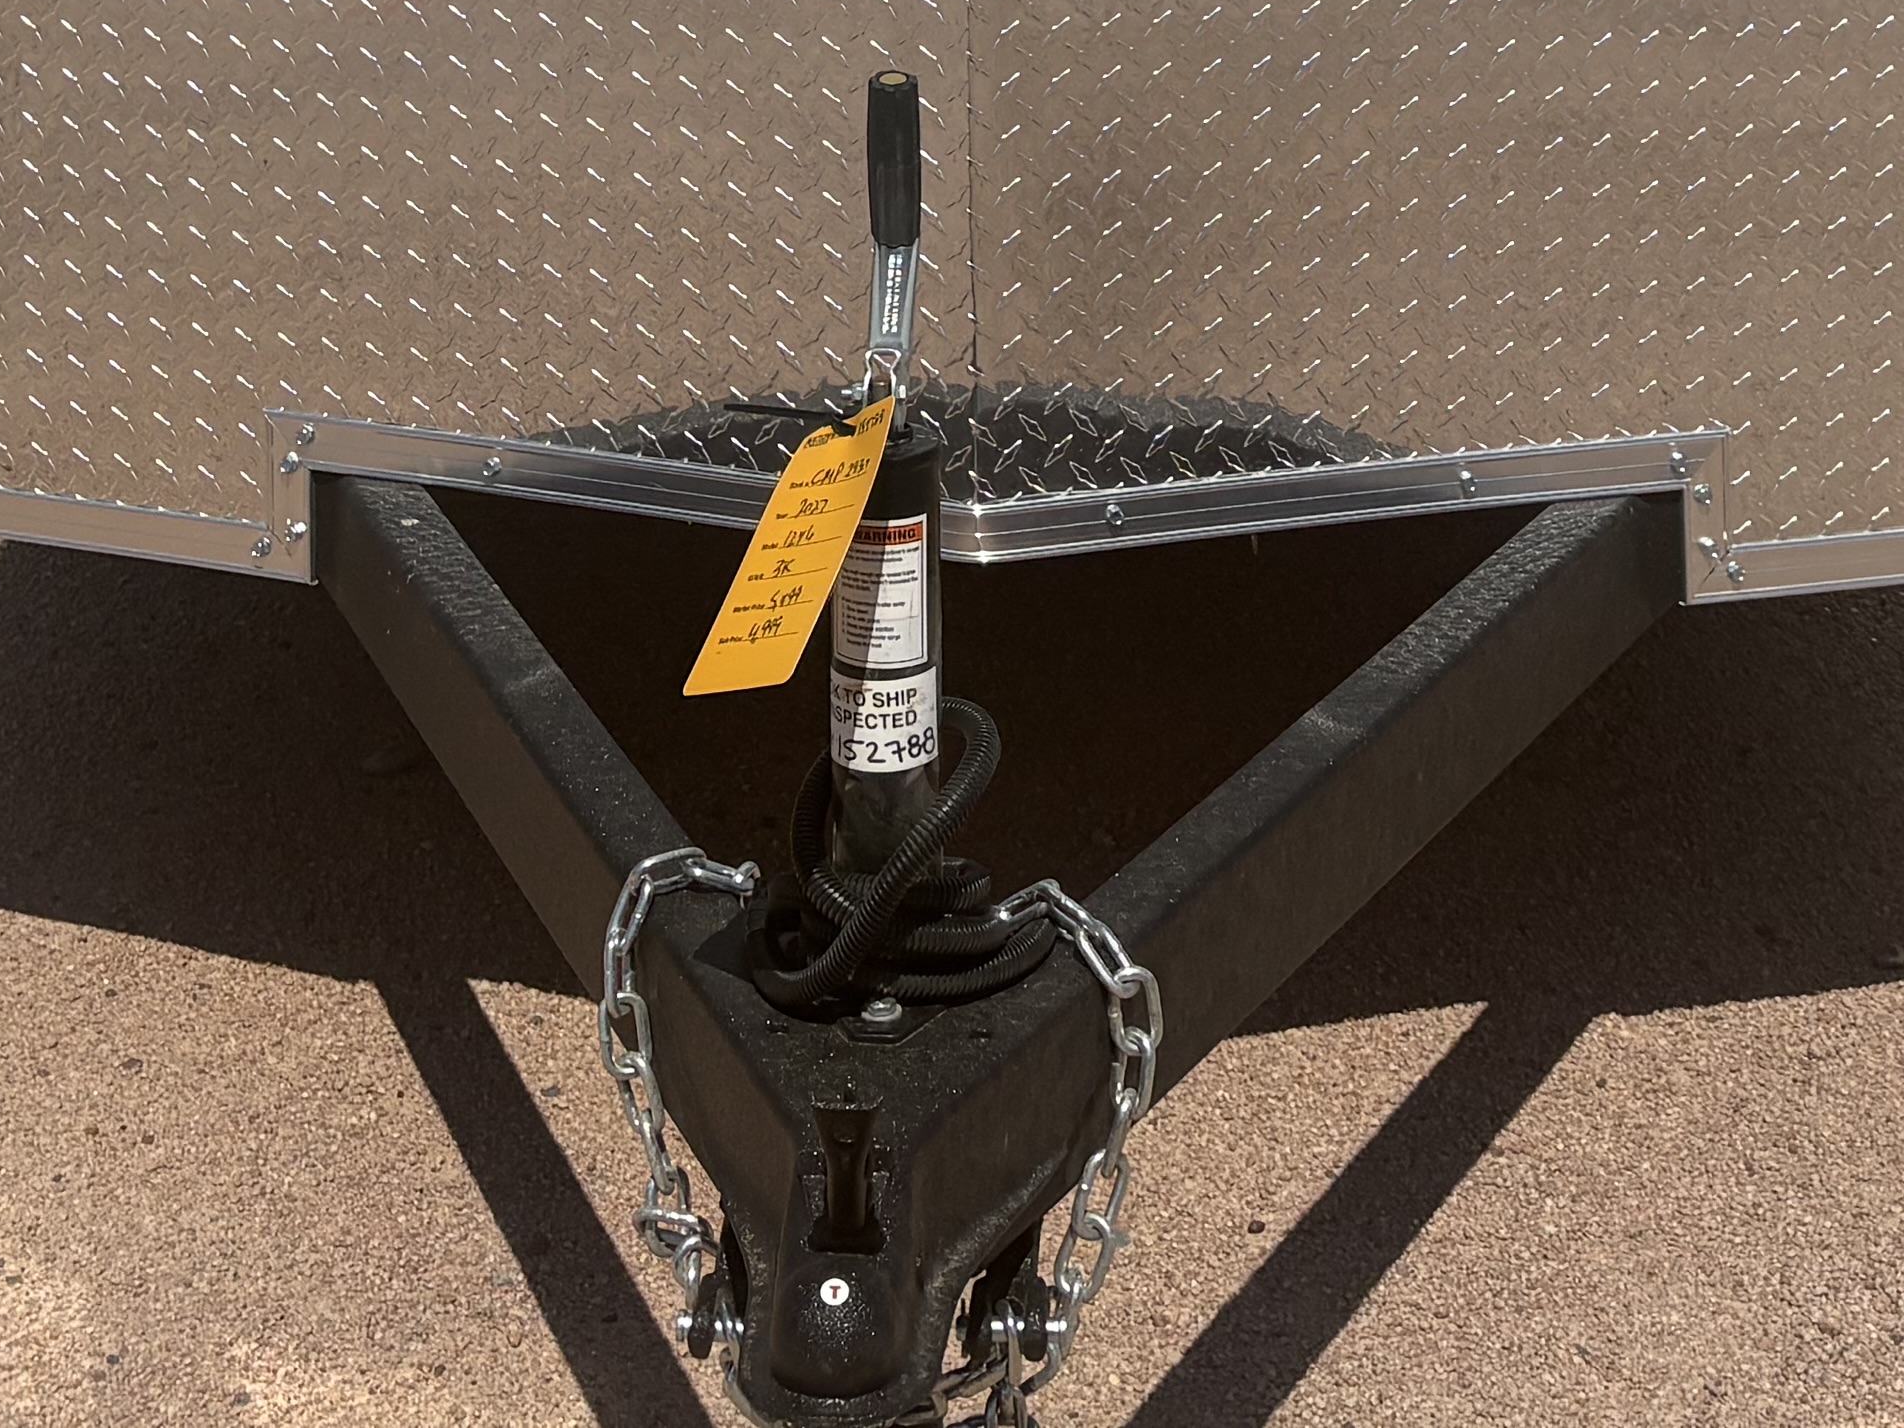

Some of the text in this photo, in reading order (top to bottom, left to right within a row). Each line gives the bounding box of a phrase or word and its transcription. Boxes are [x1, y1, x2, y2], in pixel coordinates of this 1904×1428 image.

[843, 687, 866, 707] TO
[872, 687, 917, 708] SHIP
[834, 705, 917, 730] SPECTED
[838, 726, 936, 764] 152788
